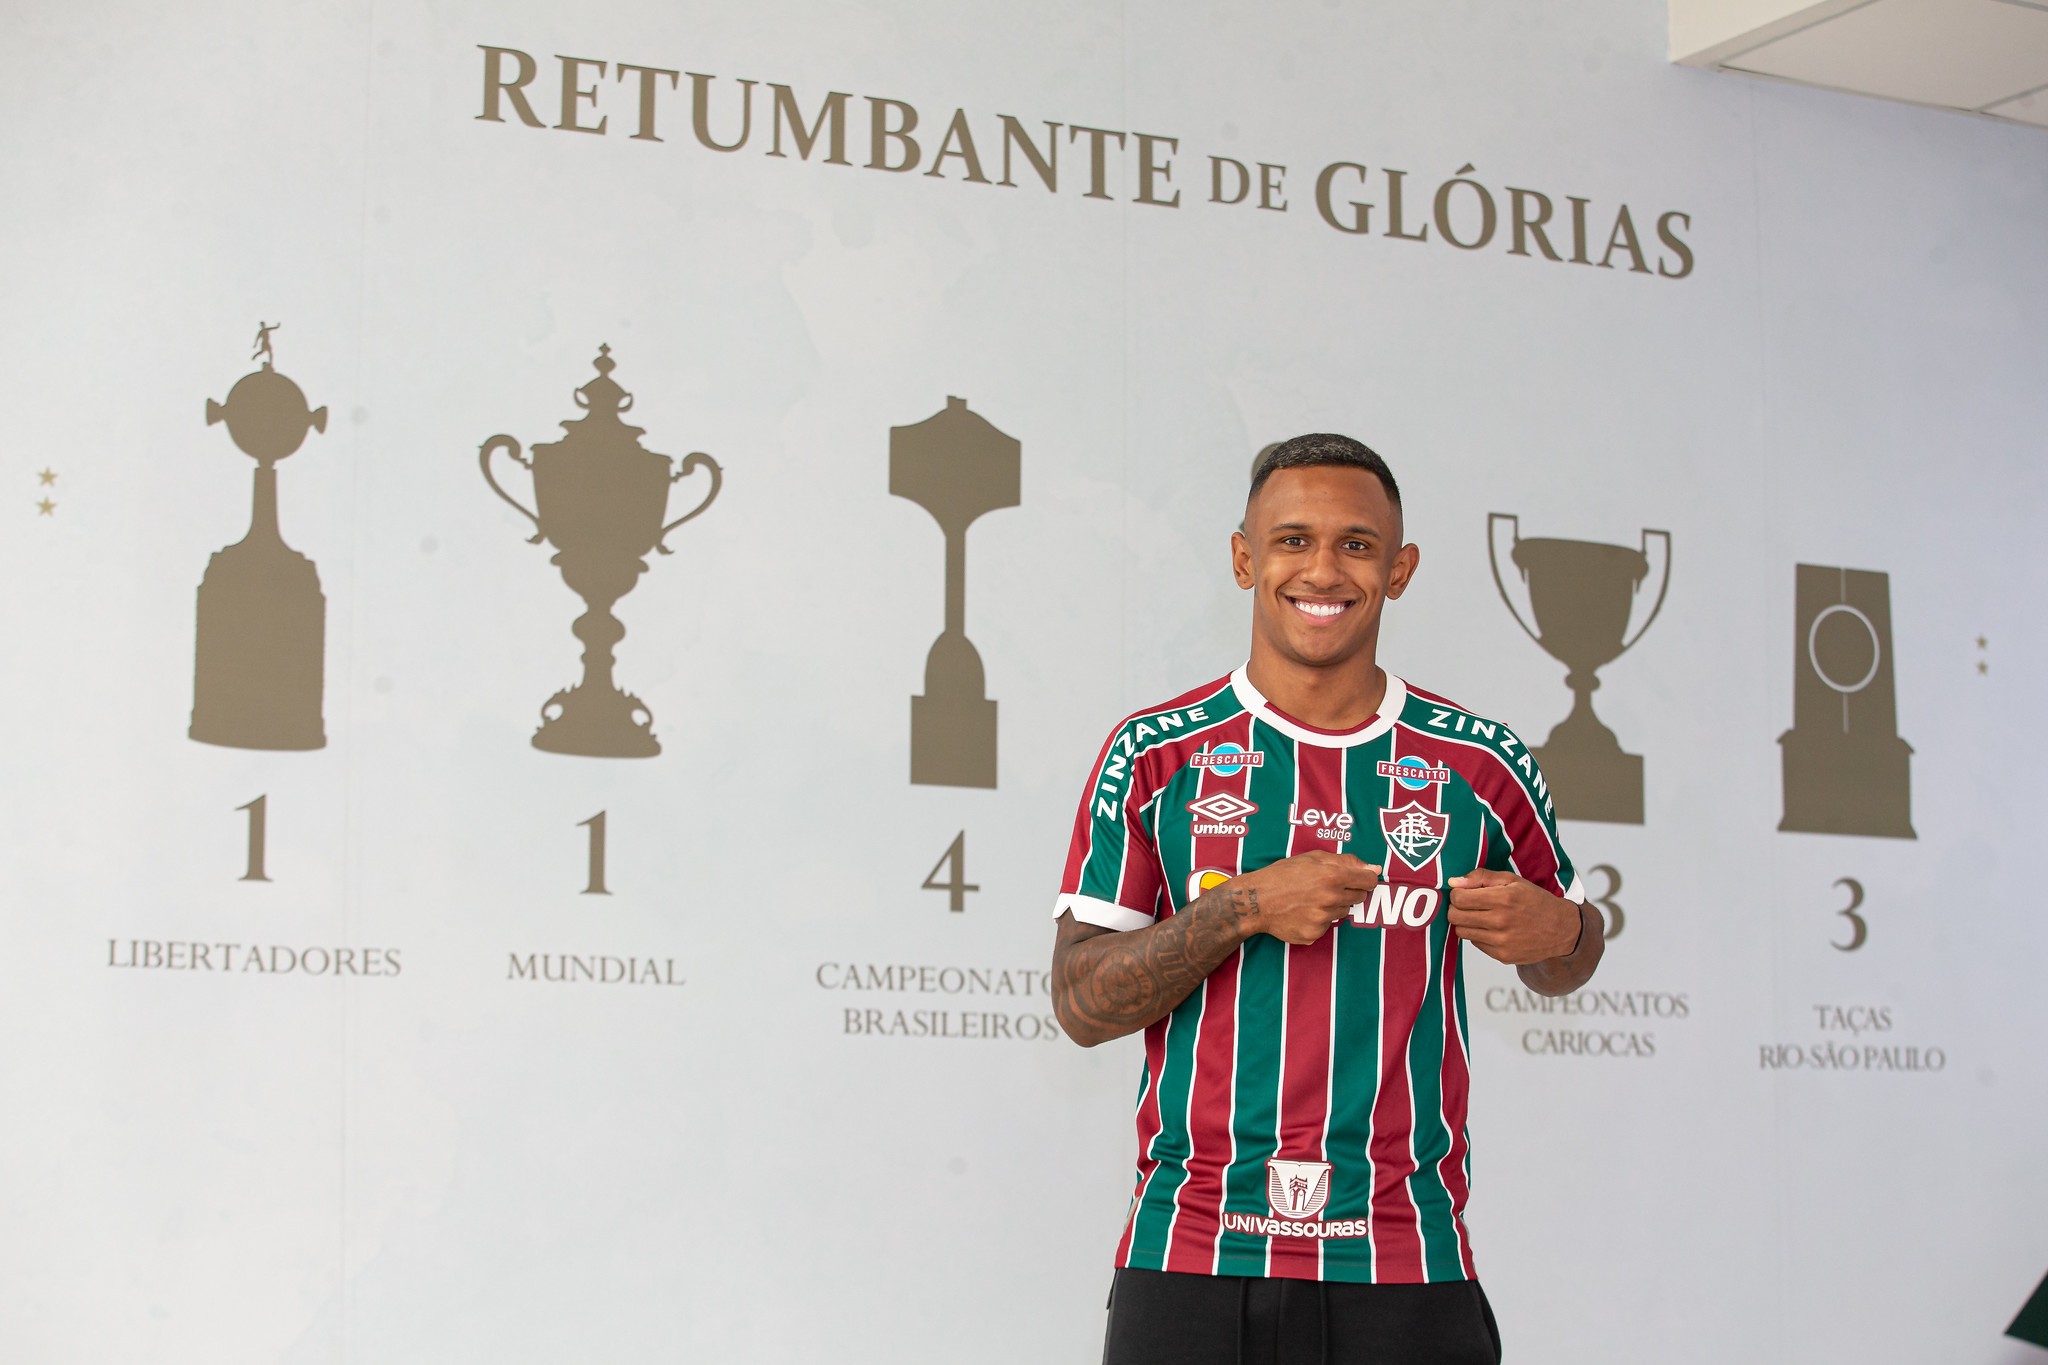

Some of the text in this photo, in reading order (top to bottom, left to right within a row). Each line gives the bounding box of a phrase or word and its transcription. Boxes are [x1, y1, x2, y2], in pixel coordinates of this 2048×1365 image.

[474, 44, 1695, 280] RETUMBANTE DE GLÓRIAS
[1097, 707, 1208, 821] ZINZANE
[1195, 754, 1260, 766] FRESCATTO
[1381, 764, 1446, 780] FRESCATTO
[1428, 708, 1553, 820] ZINZANE
[1193, 821, 1246, 835] umbro
[1289, 803, 1353, 829] Leve
[234, 794, 272, 882] 1
[1317, 827, 1351, 841] saúde
[576, 810, 612, 895] 1
[921, 829, 980, 913] 4
[1831, 877, 1868, 953] 3
[107, 938, 401, 977] LIBERTADORES
[507, 952, 686, 985] MUNDIAL
[816, 962, 1052, 996] CAMPEONAT
[843, 1007, 1059, 1041] BRASILEIROS
[1812, 1004, 1892, 1037] TAÇAS
[1522, 1029, 1656, 1057] CARIOCAS
[1863, 1045, 1946, 1073] PAULO
